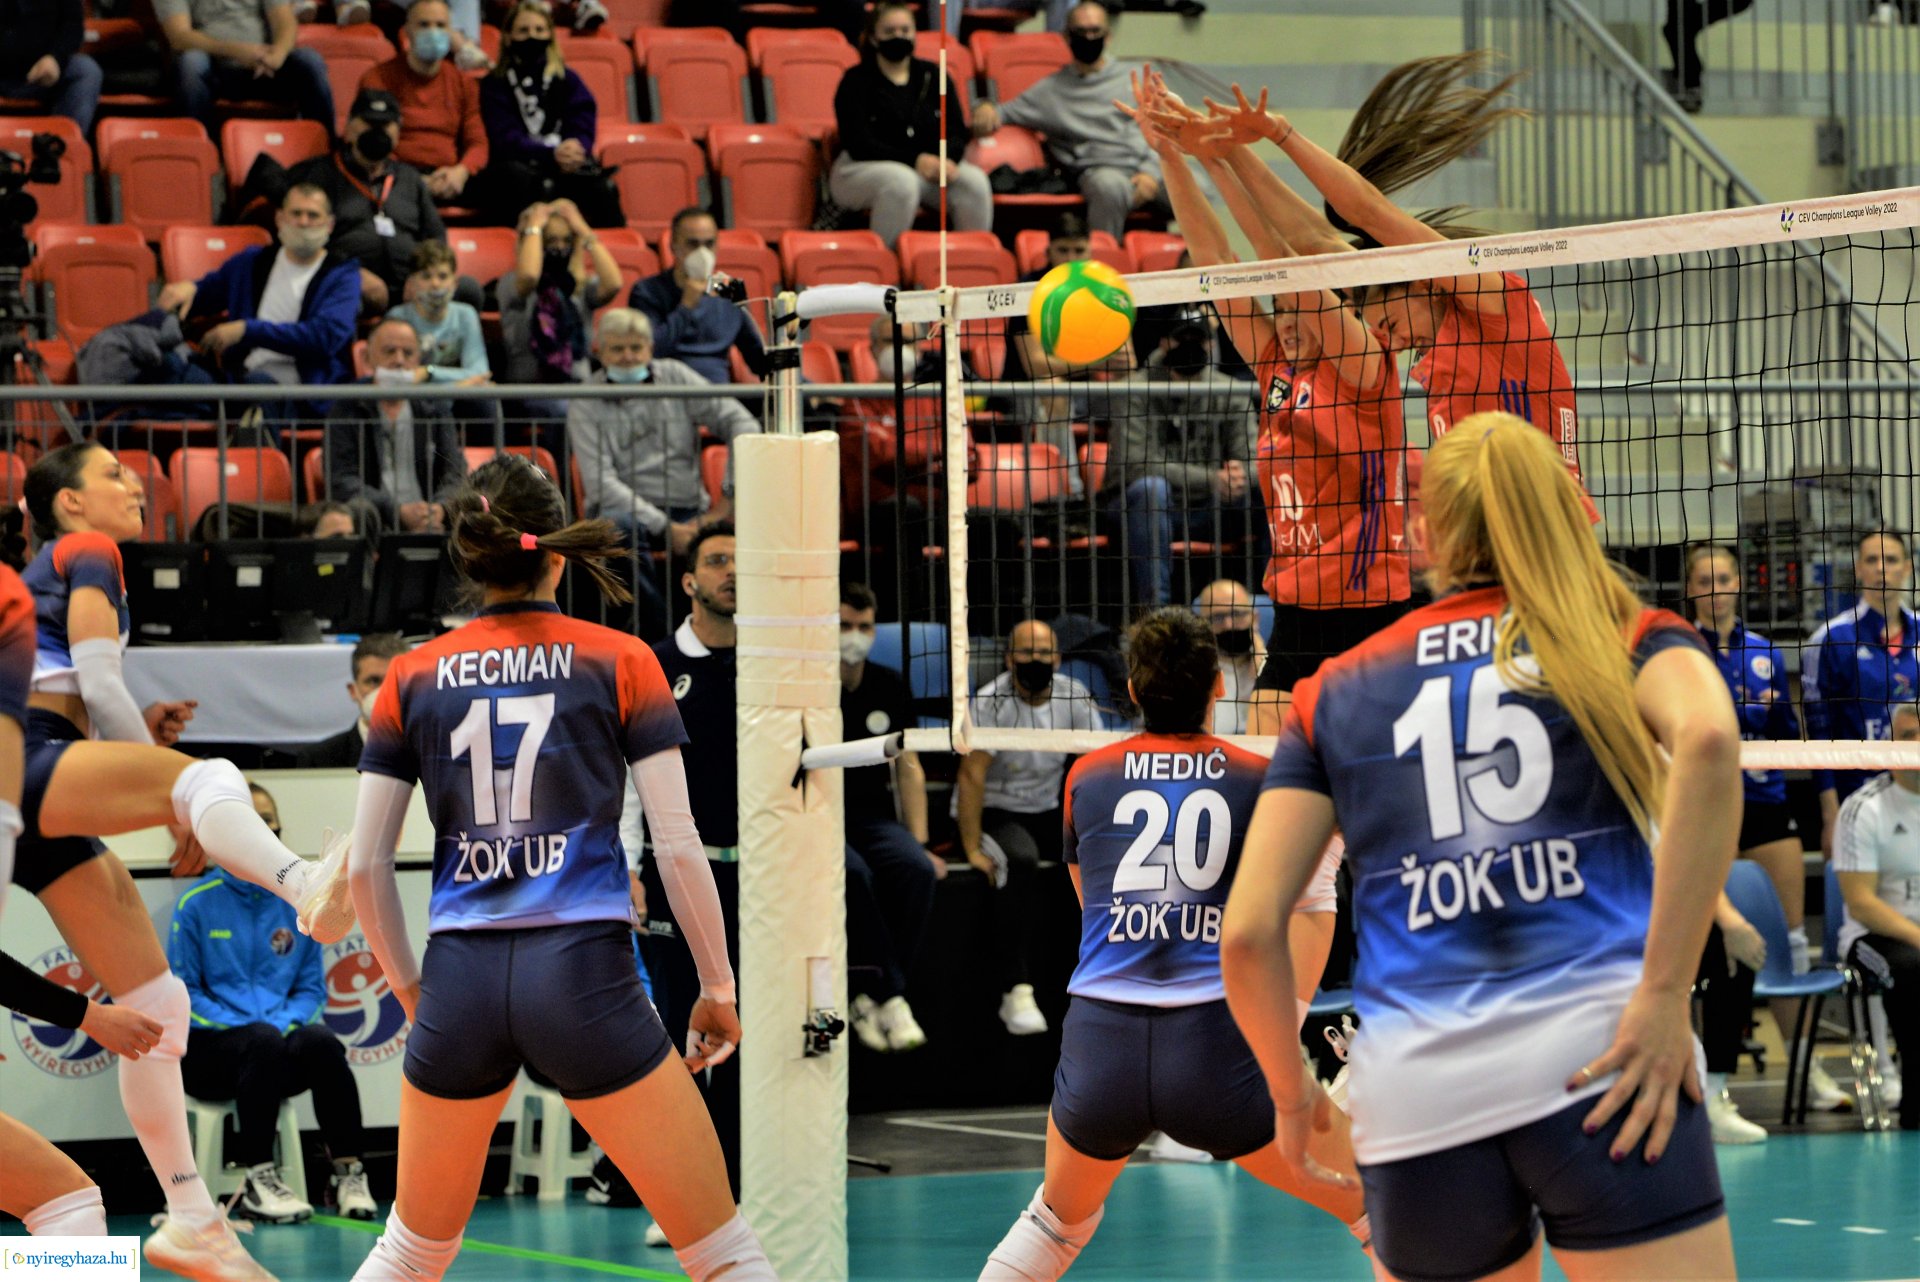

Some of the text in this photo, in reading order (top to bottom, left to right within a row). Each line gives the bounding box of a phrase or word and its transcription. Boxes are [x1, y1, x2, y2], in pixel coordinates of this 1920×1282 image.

[1798, 202, 1898, 223] CEV Champions League Volley 2022
[1483, 240, 1568, 258] CEV Champions League Volley 2022
[999, 291, 1017, 307] CEV
[1271, 473, 1304, 522] 10
[436, 643, 574, 690] KECMAN
[449, 692, 556, 827] 17
[1124, 747, 1227, 780] MEDIĆ
[1392, 654, 1553, 842] 15
[453, 831, 568, 883] ŽOK UB
[1112, 788, 1232, 894] 20
[1400, 838, 1585, 932] ŽOK UB
[1108, 896, 1223, 944] ŽOK UB
